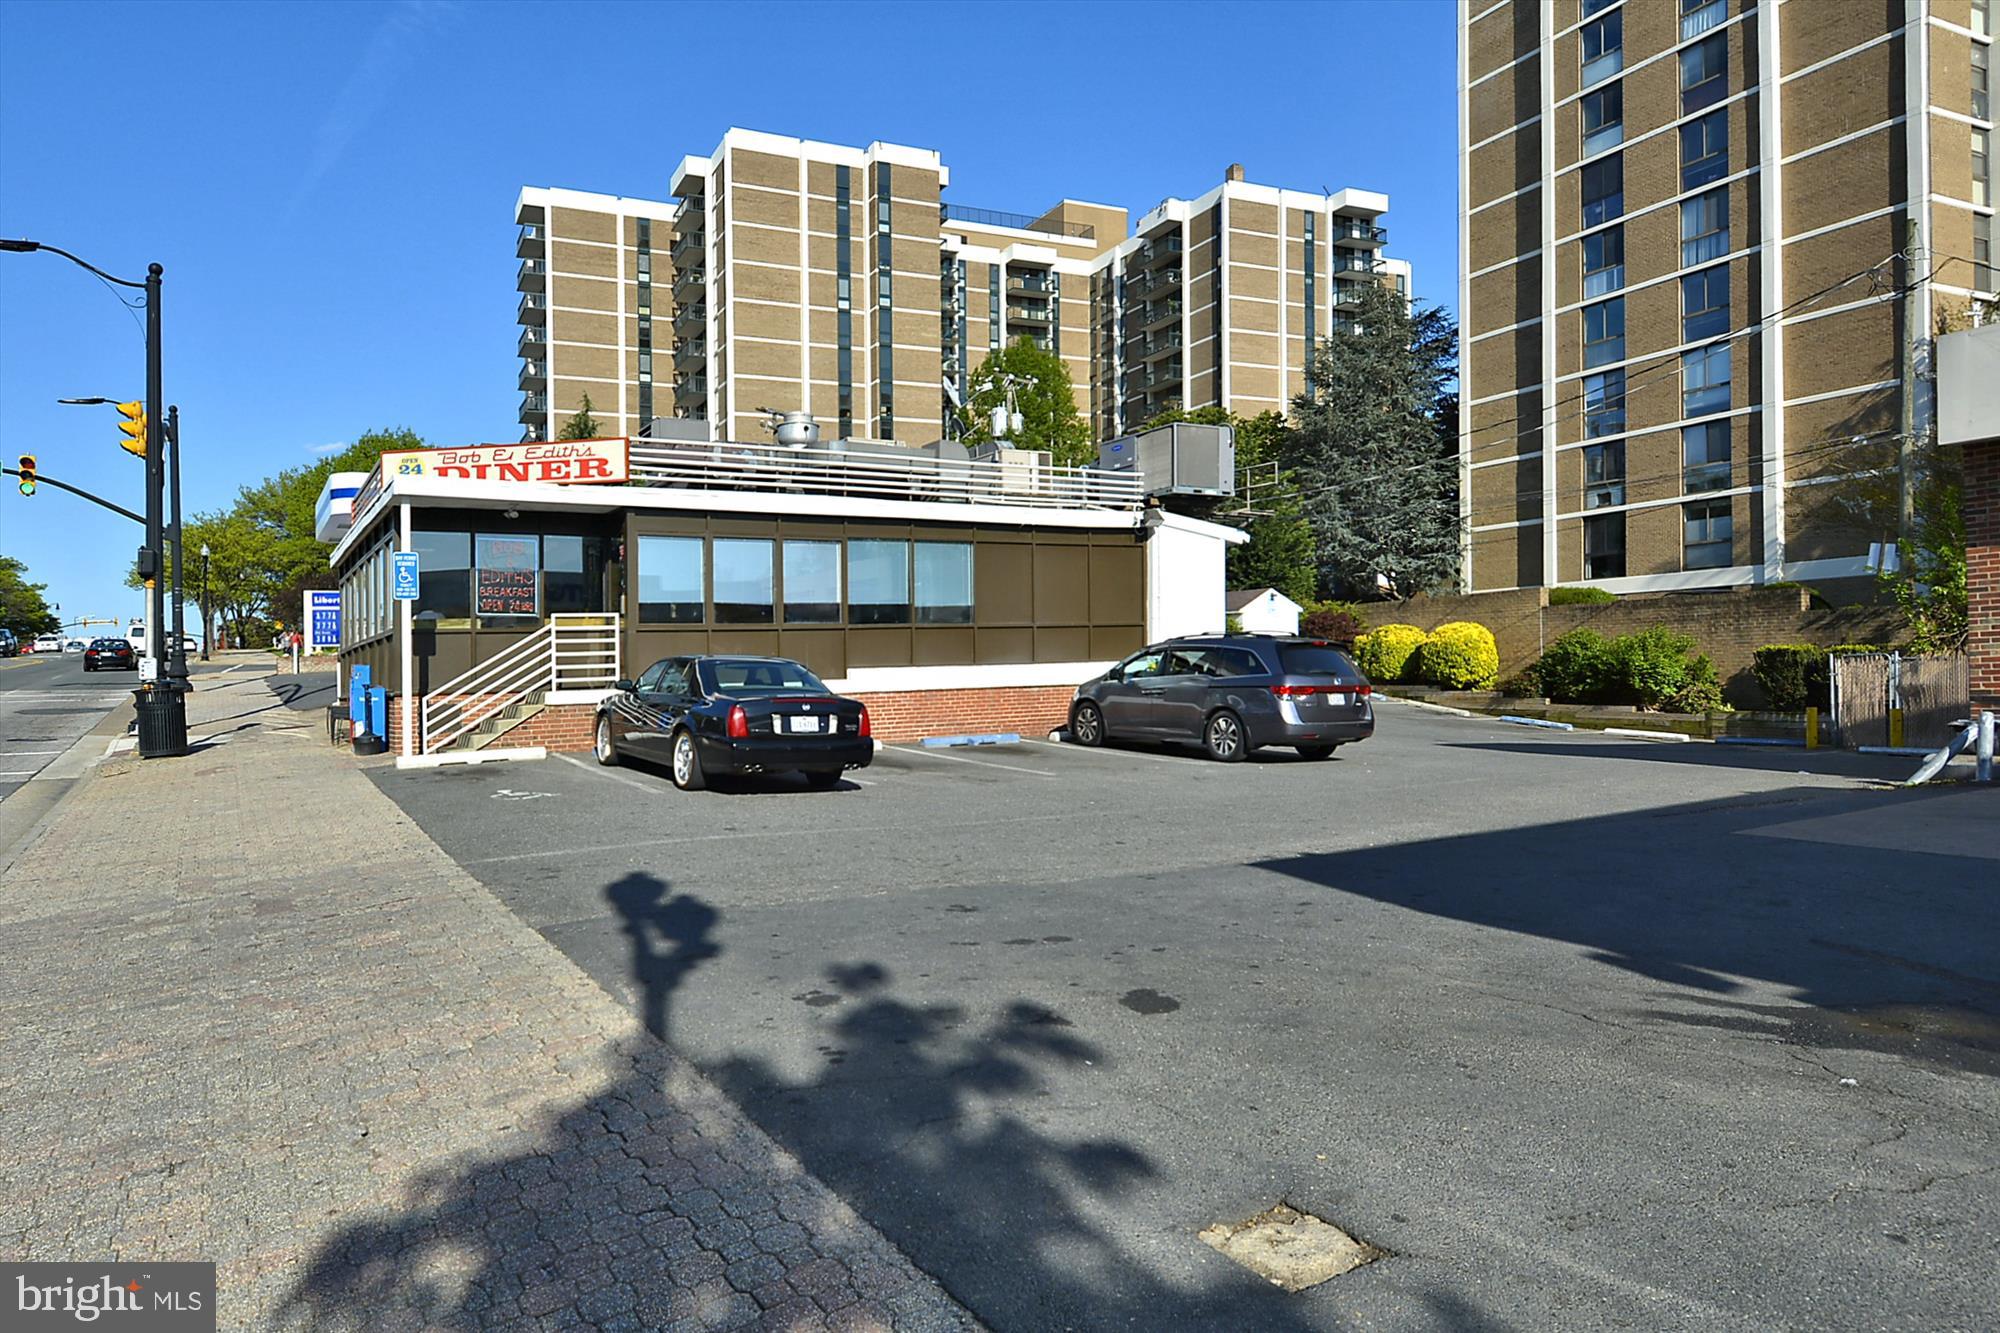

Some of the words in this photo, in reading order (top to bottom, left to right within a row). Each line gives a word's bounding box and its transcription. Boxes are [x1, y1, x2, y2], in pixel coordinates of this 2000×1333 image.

[437, 451, 481, 465] Bob
[525, 444, 596, 460] Edith's
[398, 463, 422, 475] 24
[433, 458, 613, 482] DINER
[479, 586, 535, 597] BREAKFAST
